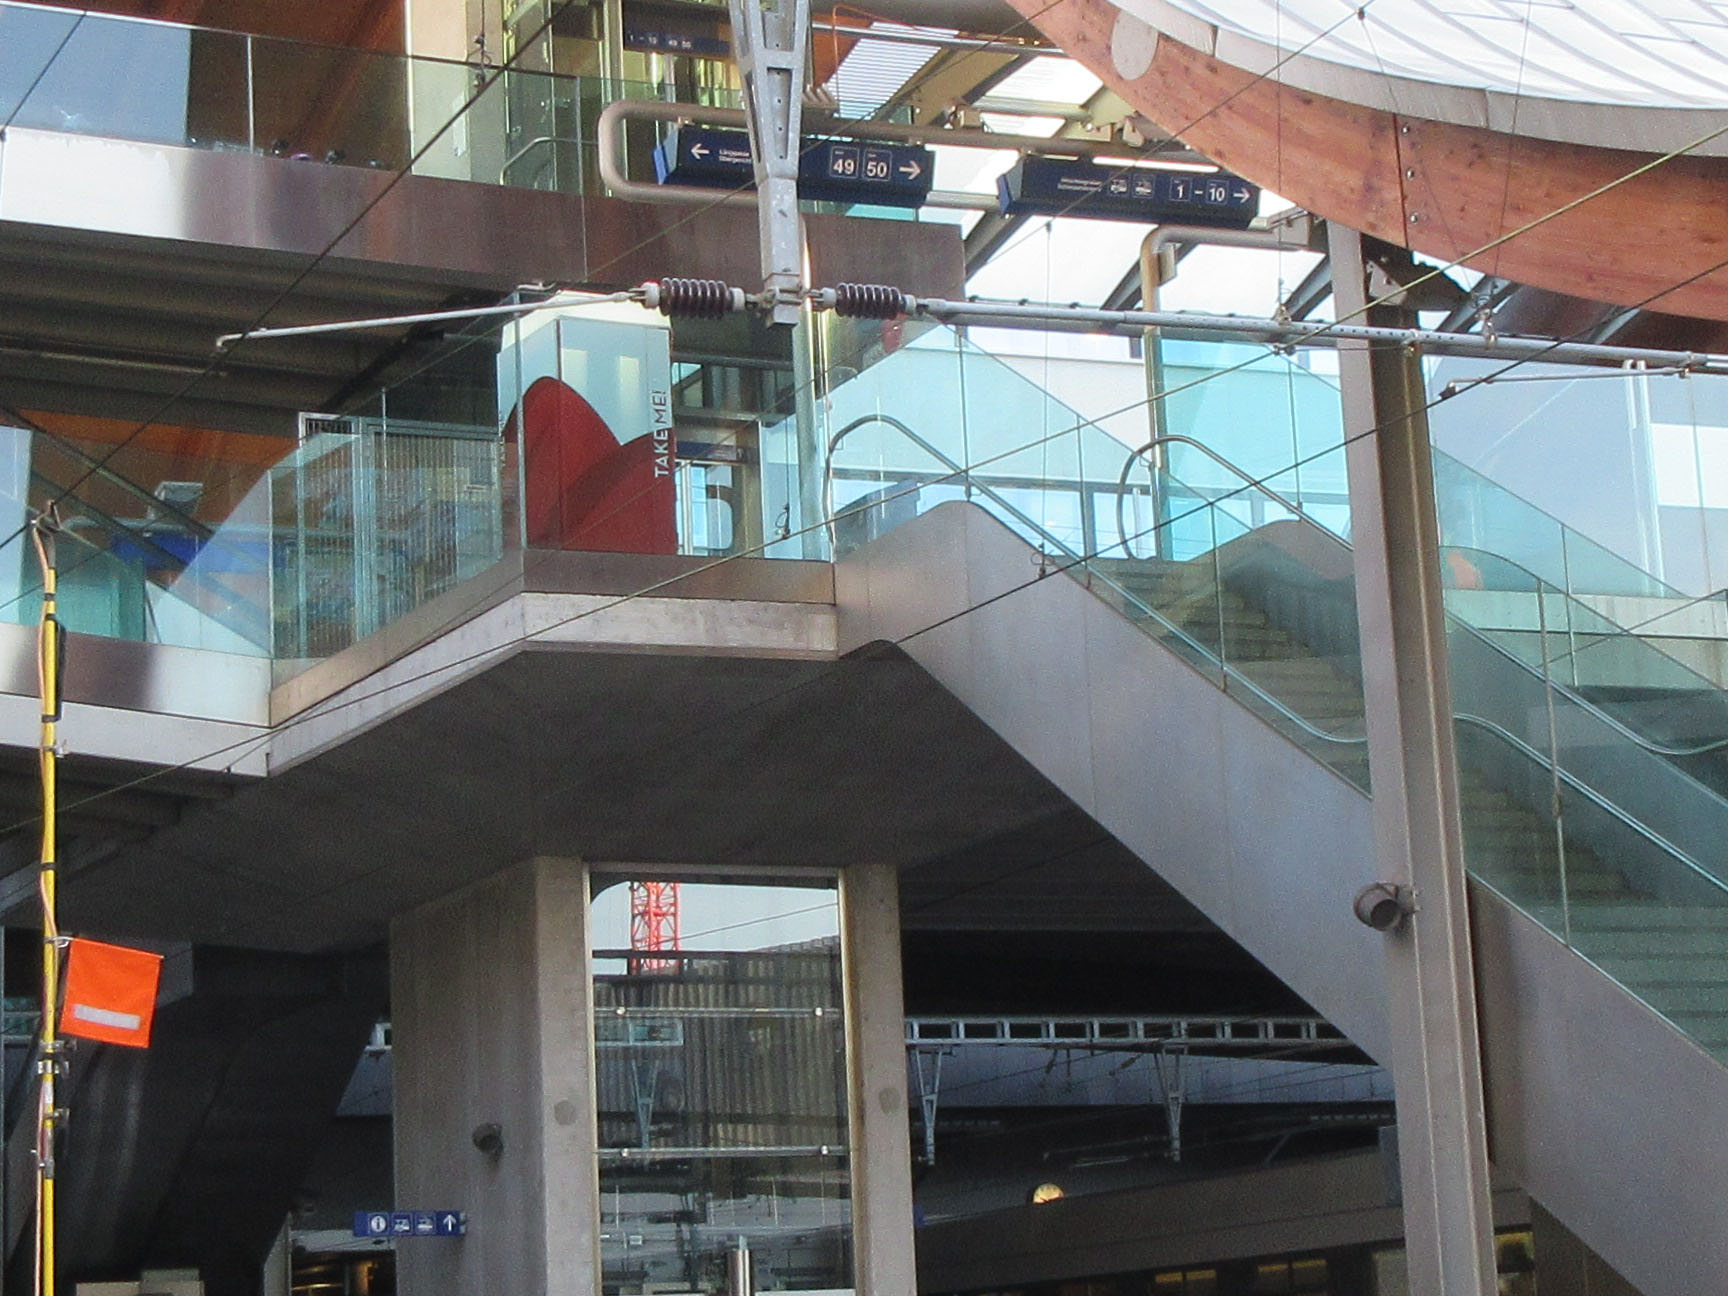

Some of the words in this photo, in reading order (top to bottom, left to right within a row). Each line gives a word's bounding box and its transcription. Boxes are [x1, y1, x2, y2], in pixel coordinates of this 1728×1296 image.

[832, 158, 855, 176] 49
[866, 160, 888, 179] 50
[1176, 185, 1184, 199] 1
[1208, 187, 1225, 202] 10
[649, 389, 668, 426] ME!
[654, 427, 669, 479] TAKE
